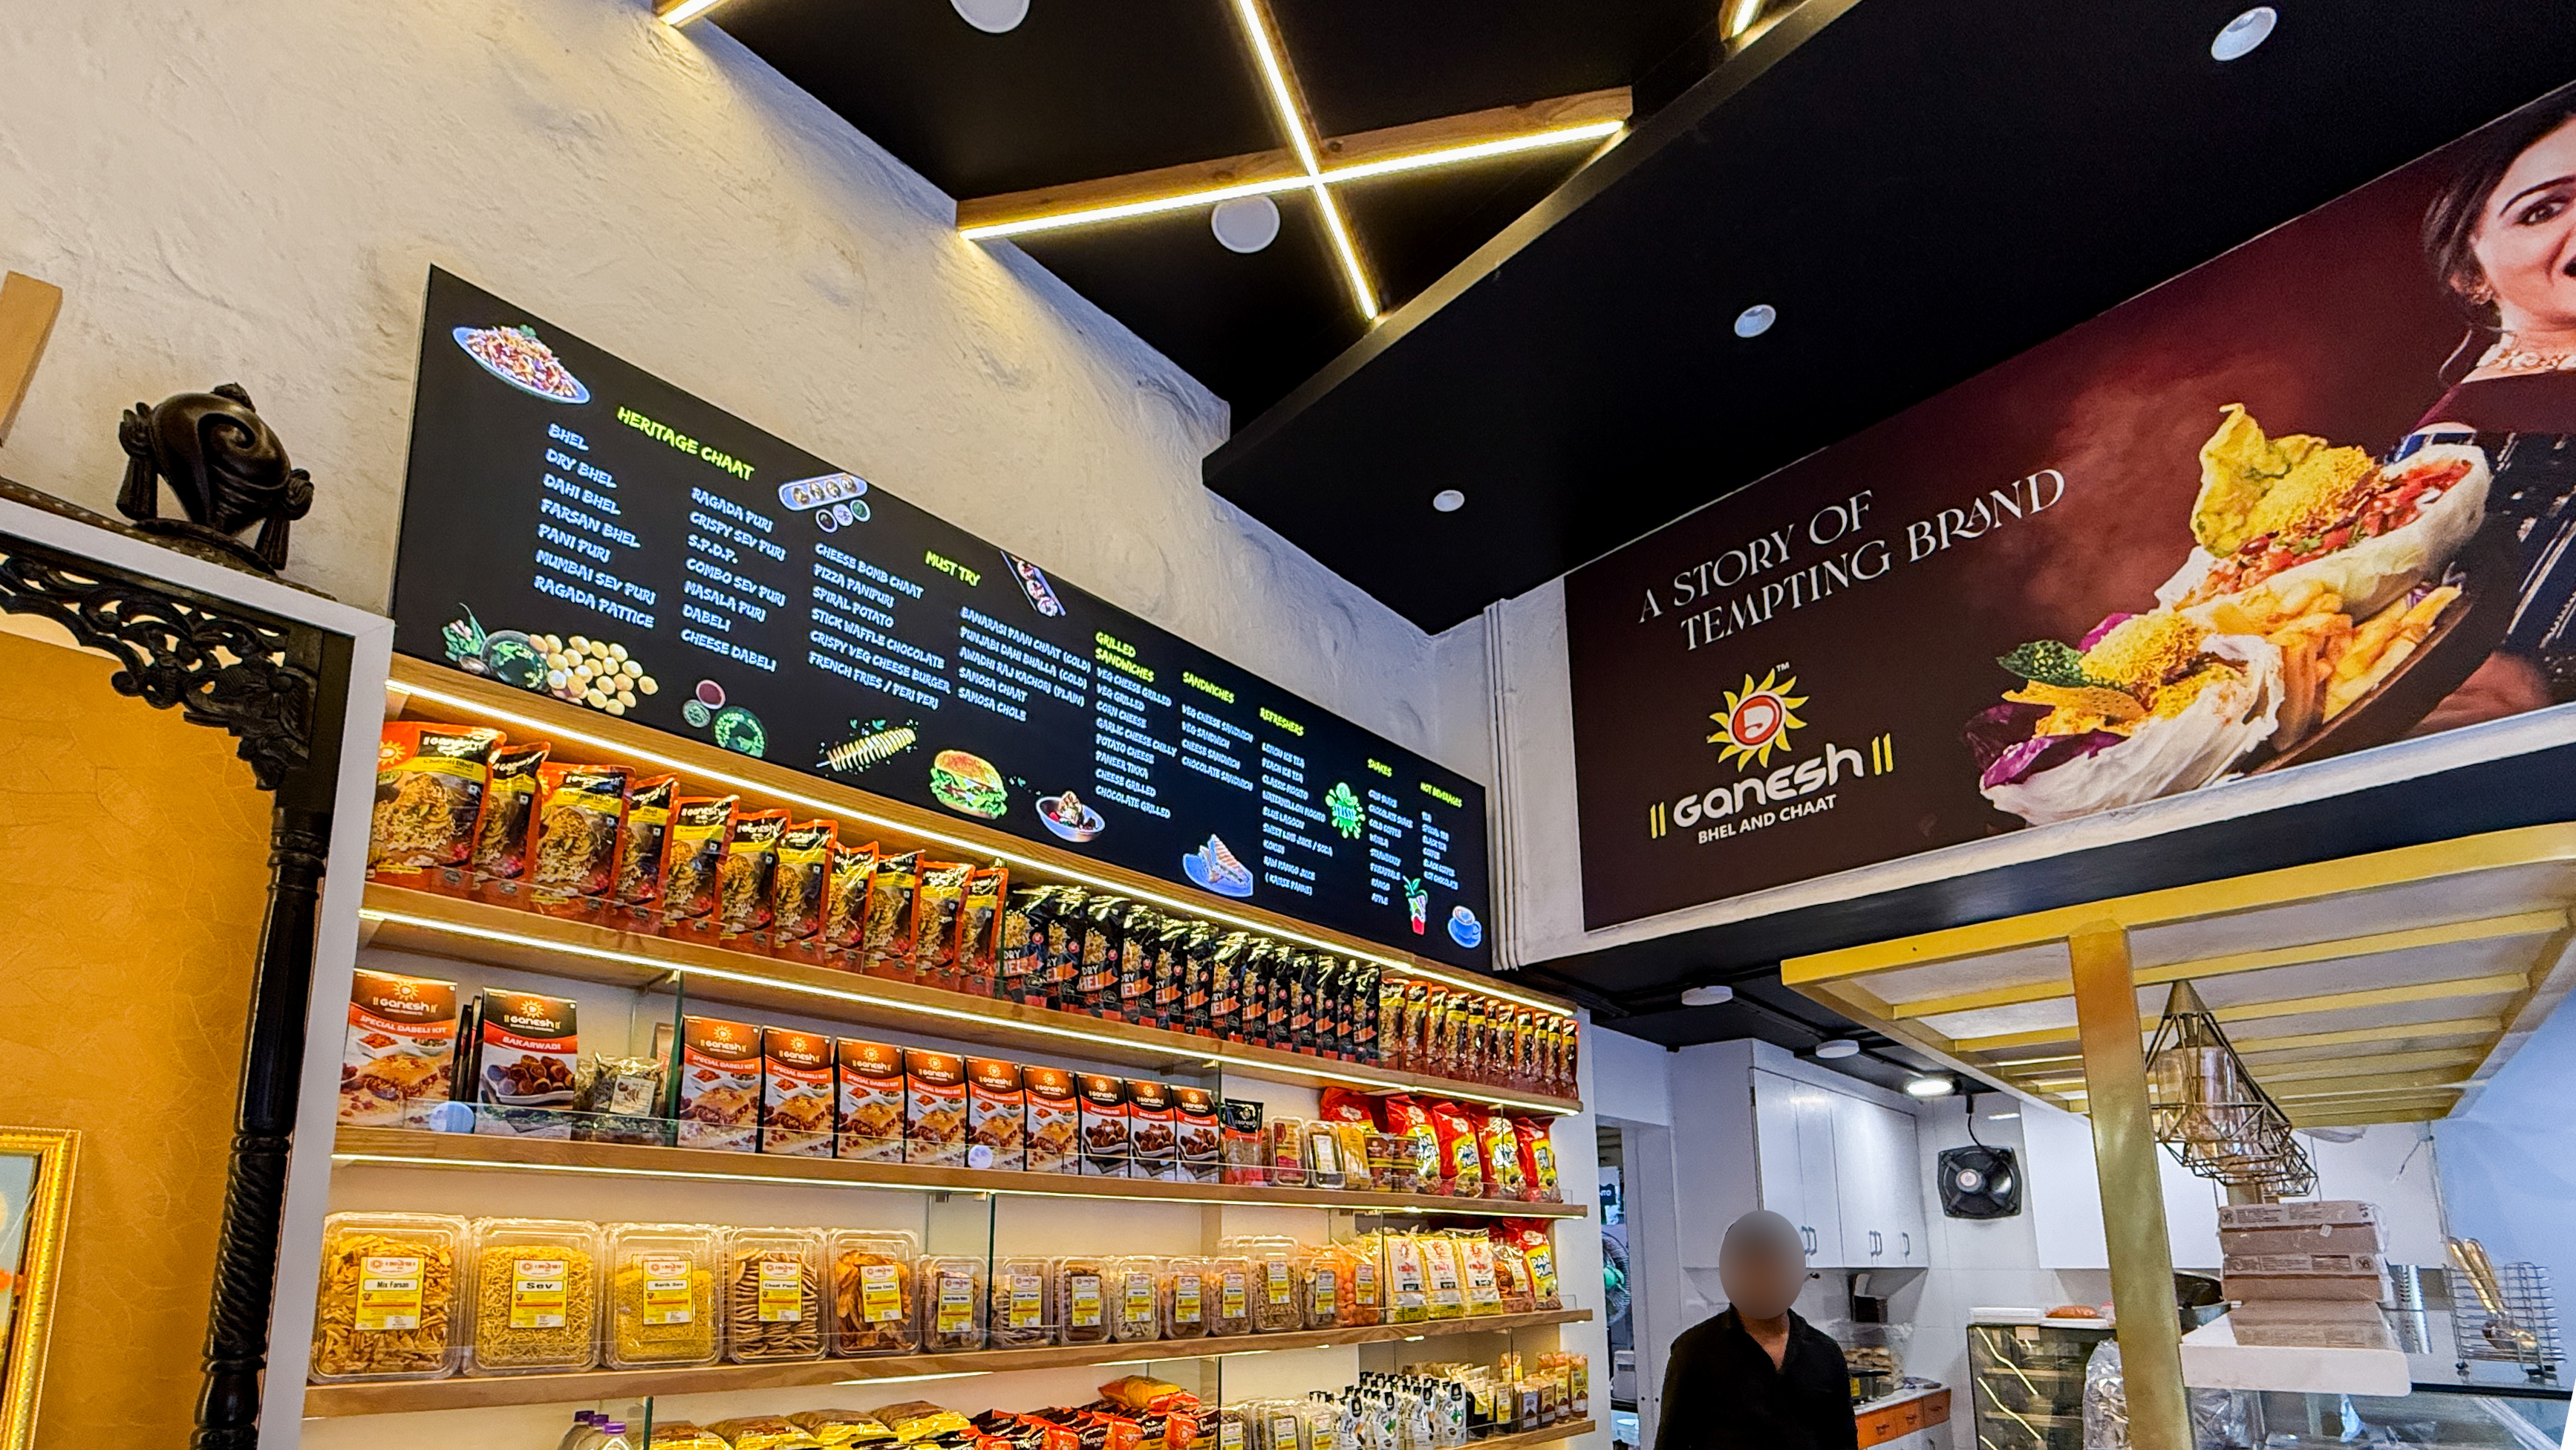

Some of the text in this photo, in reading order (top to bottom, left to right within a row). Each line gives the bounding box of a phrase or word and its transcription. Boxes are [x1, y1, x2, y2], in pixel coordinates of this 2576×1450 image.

[548, 424, 588, 451] BHEL
[618, 407, 754, 481] HERITAGE CHAAT
[546, 449, 616, 488] DRY BHEL
[544, 474, 621, 516] DAHI BHEL
[692, 487, 774, 533] RAGADA PURI
[538, 524, 611, 563] PANI PURI
[541, 498, 641, 548] FARSAN BHEL
[690, 512, 786, 562] CRISPY SEV PURI
[688, 535, 738, 564] S.P.D.P.
[815, 543, 924, 599] CHEESE BOMB CHAAT
[926, 551, 981, 586] MUST TRY
[1639, 490, 1873, 622] A STORY OF
[1680, 468, 2065, 650] TEMPTING BRAND
[536, 550, 656, 605] MUMBAI SEV PURI
[685, 559, 786, 607] COMBO SEV PURI
[814, 564, 846, 588] PIZZA
[535, 576, 655, 628] RAGADA PATTICE
[682, 604, 731, 632] DABELI
[737, 601, 766, 622] PURI
[813, 586, 894, 628] SPIRAL POTATO
[682, 629, 777, 672] CHEESE DABELI
[812, 608, 945, 669] STICK WAFFLE CHOCOLATE
[960, 607, 1091, 674] BANARASI PAAN CHAAT (COLD)
[809, 651, 939, 710] FRENCH FRIES / PERI PERI
[810, 631, 951, 695] CRISPY VEG CHEESE BURGER
[997, 662, 1014, 678] RAJ
[1054, 686, 1085, 707] (PLAIN)
[1000, 643, 1023, 663] DAHI
[1059, 669, 1087, 690] (COLD)
[959, 667, 1028, 703] SAMOSA CHAAT
[959, 688, 1027, 721] SAMOSA CHOLE
[1368, 758, 1392, 777] SHAKES
[1698, 794, 1837, 845] BHEL AND CHAAT
[1078, 975, 1102, 991] HEL
[360, 1015, 396, 1031] SPECIAL
[432, 1026, 447, 1035] KIT
[502, 1036, 561, 1050] BAKARWADI
[377, 1281, 409, 1289] Mix Farsan
